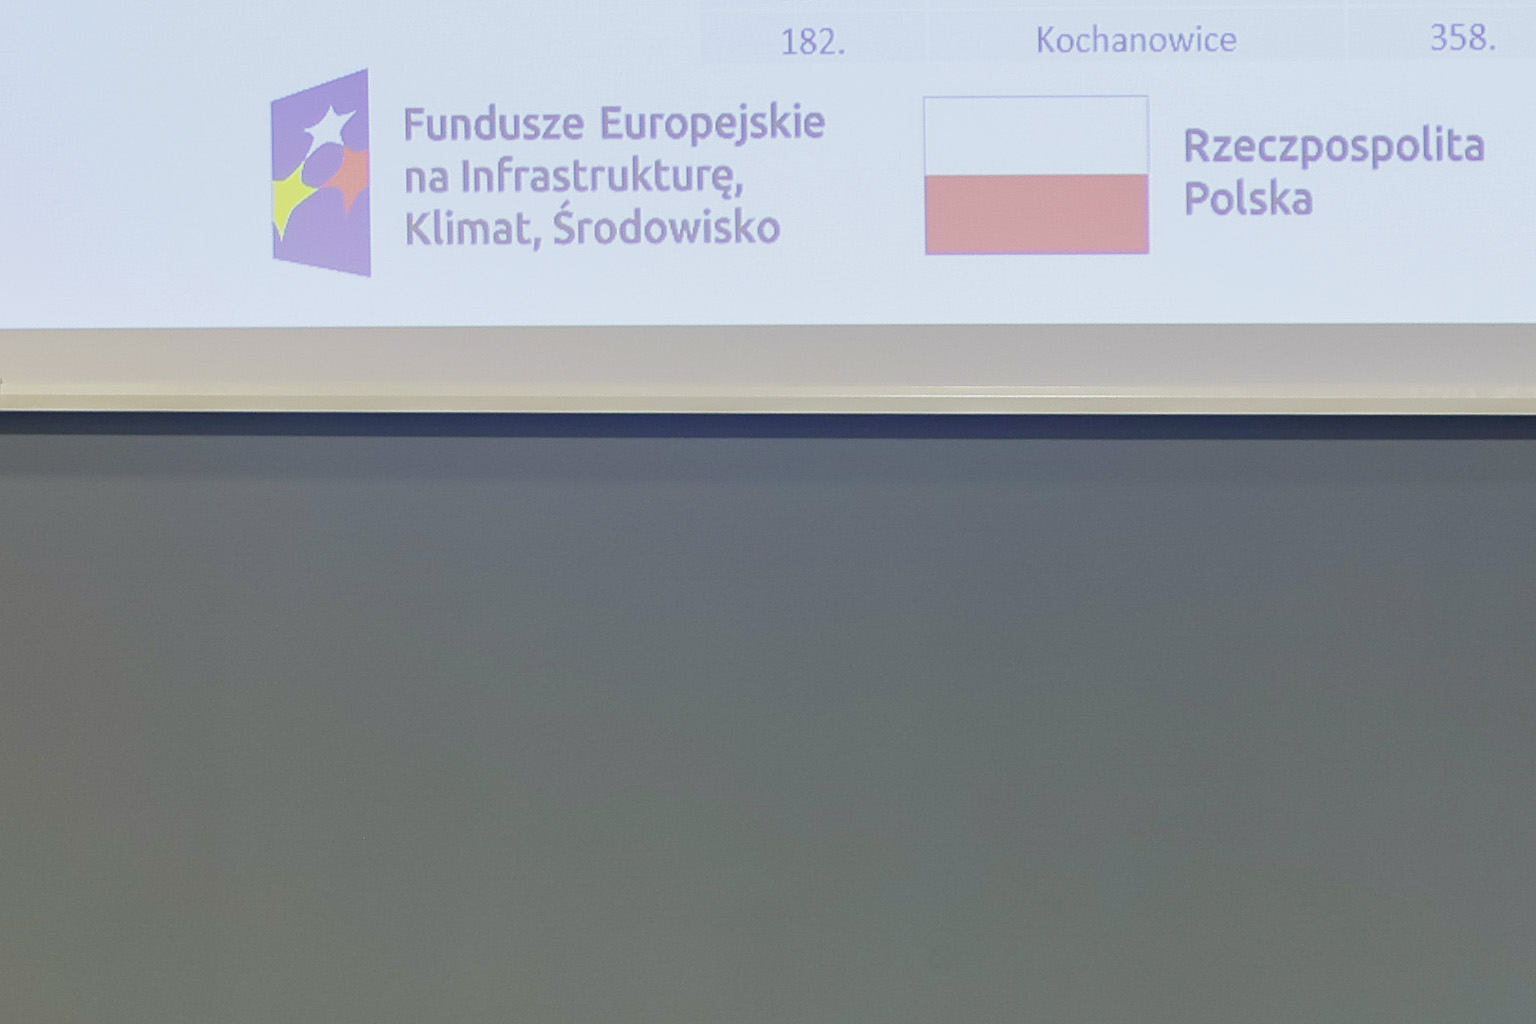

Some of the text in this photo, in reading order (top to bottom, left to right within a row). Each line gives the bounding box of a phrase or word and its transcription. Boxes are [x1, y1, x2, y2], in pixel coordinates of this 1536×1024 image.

[783, 24, 1237, 55] 182. Kochanowice
[1432, 24, 1495, 51] 358.
[405, 101, 825, 147] Fundusze Europejskie
[1185, 124, 1484, 170] Rzeczpospolita
[406, 155, 742, 200] na Infrastrukturę,
[1186, 178, 1312, 215] Polska
[407, 200, 780, 252] Klimat, Środowisko
